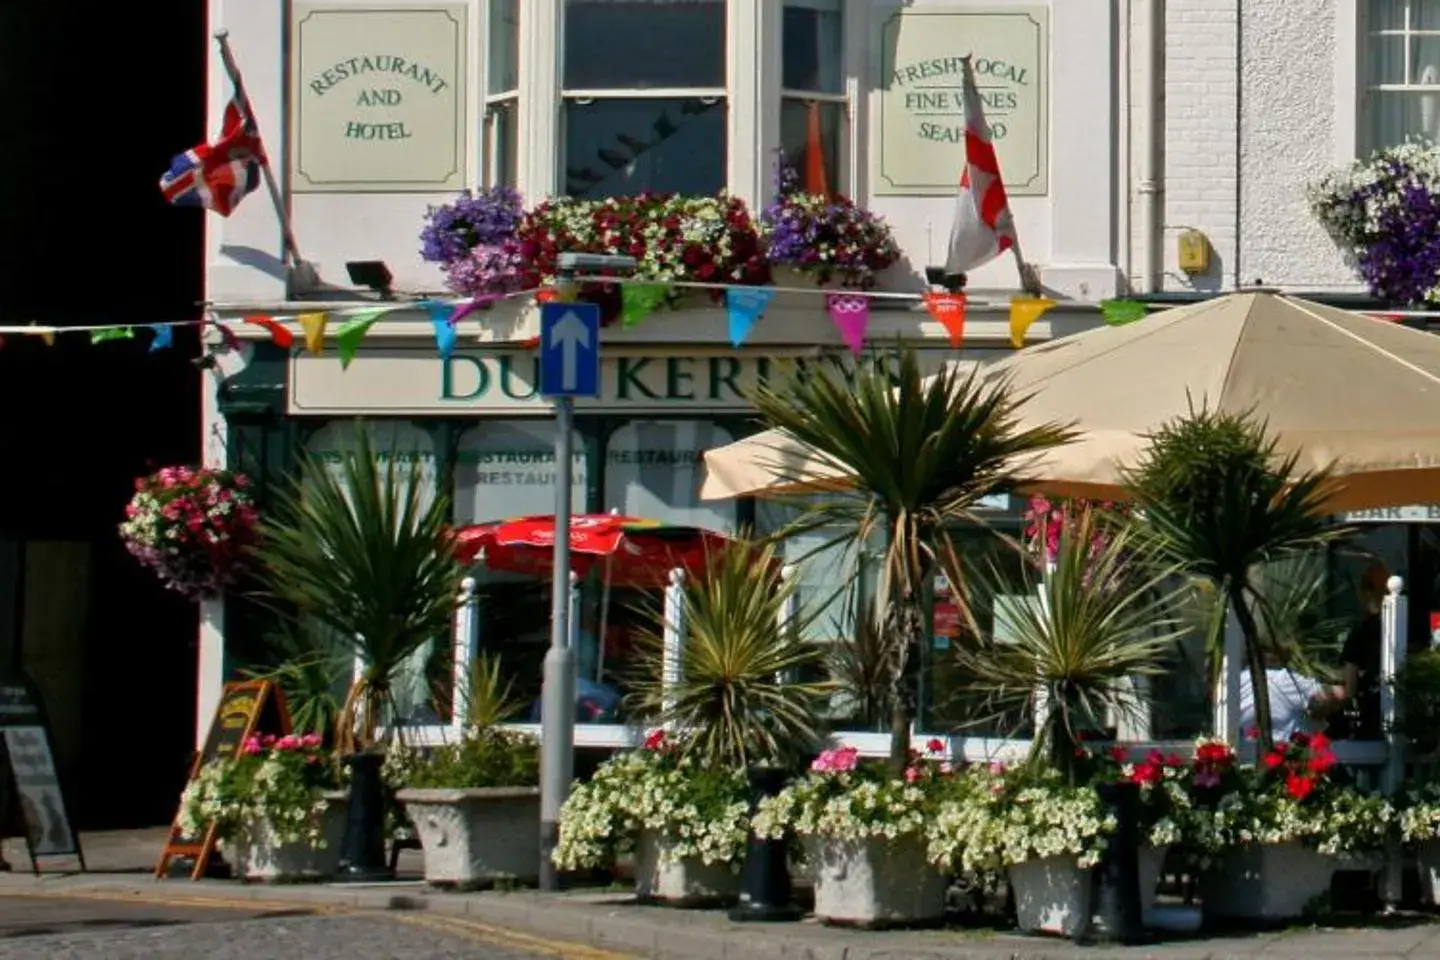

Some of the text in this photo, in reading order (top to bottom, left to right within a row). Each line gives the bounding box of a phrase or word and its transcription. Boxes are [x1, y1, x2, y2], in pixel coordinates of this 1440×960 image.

[309, 55, 449, 96] RESTAURANT
[893, 57, 1029, 86] FRESH OCAL
[356, 90, 402, 107] AND
[905, 93, 948, 109] FINE
[345, 121, 413, 140] HOTEL
[918, 122, 1007, 144] SEAFD
